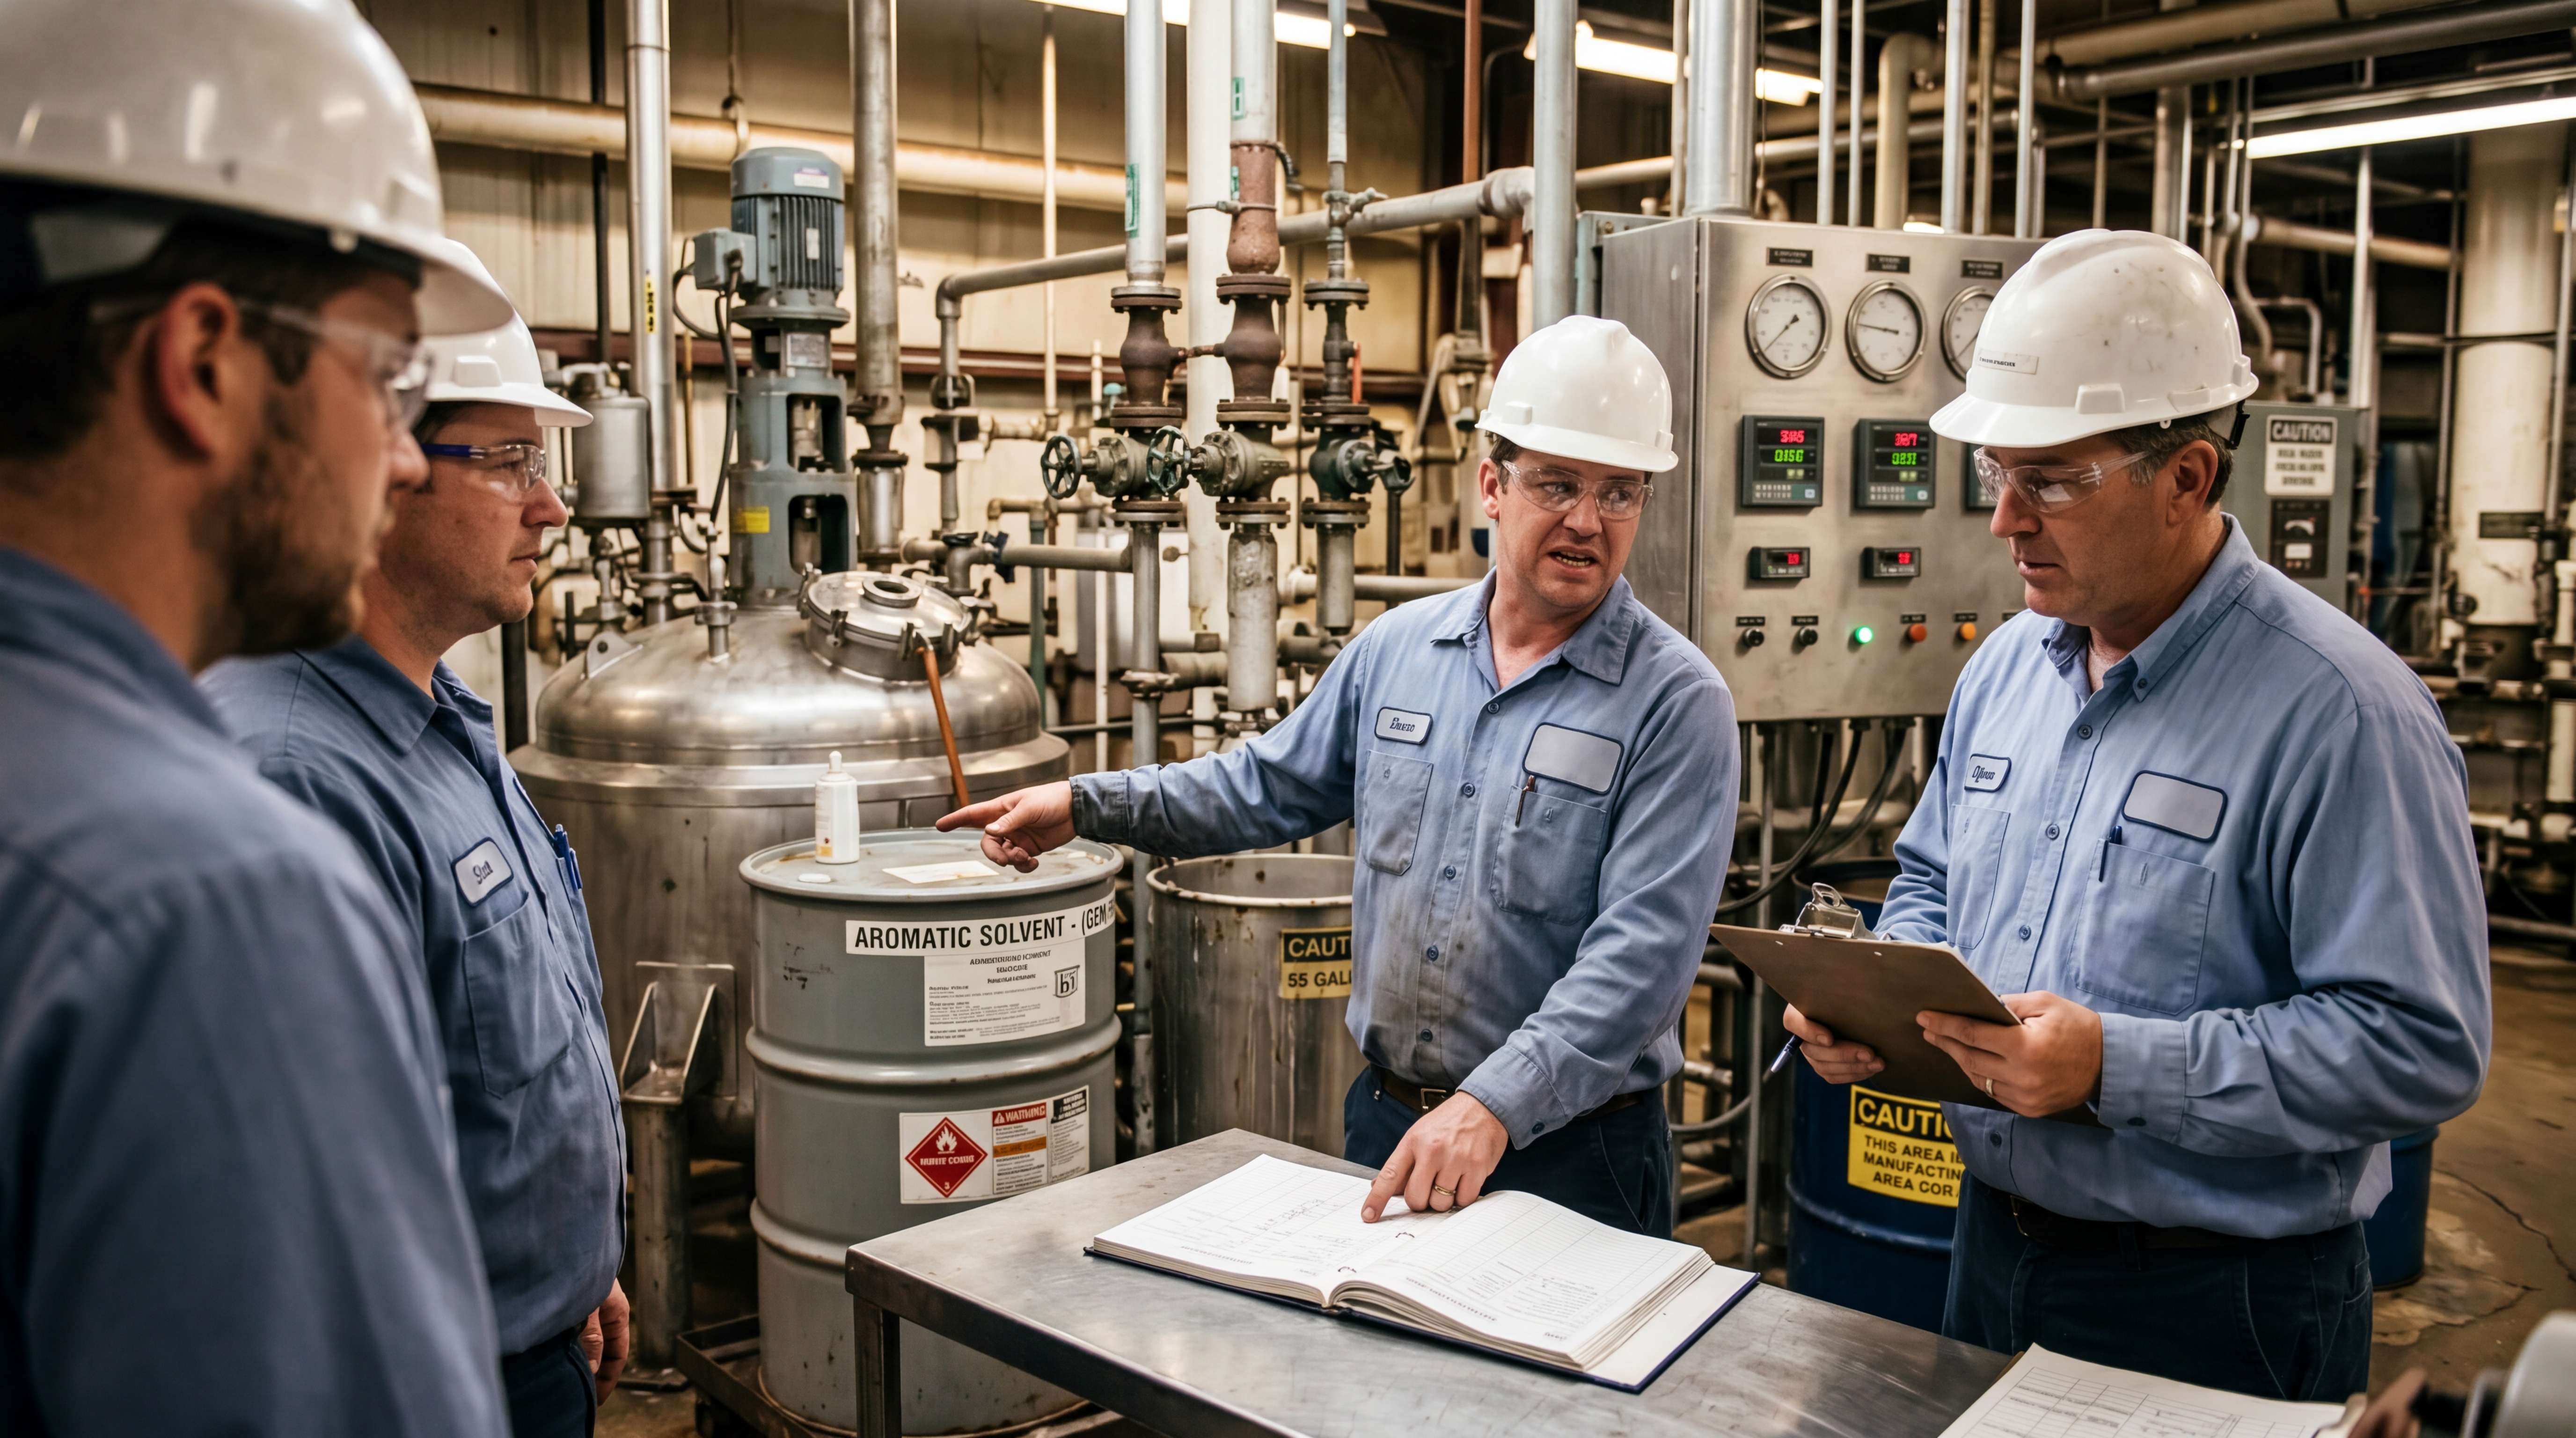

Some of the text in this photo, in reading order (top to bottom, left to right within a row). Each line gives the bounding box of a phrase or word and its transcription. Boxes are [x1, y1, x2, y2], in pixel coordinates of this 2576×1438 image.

[2273, 422, 2331, 440] CAUTION
[855, 926, 971, 949] AROMATIC
[980, 916, 1066, 947] SOLVENT
[1288, 937, 1349, 957] CAUT
[1865, 1135, 1897, 1154] THIS
[1902, 1145, 1944, 1162] AREA
[1873, 1172, 1953, 1197] AREA COR
